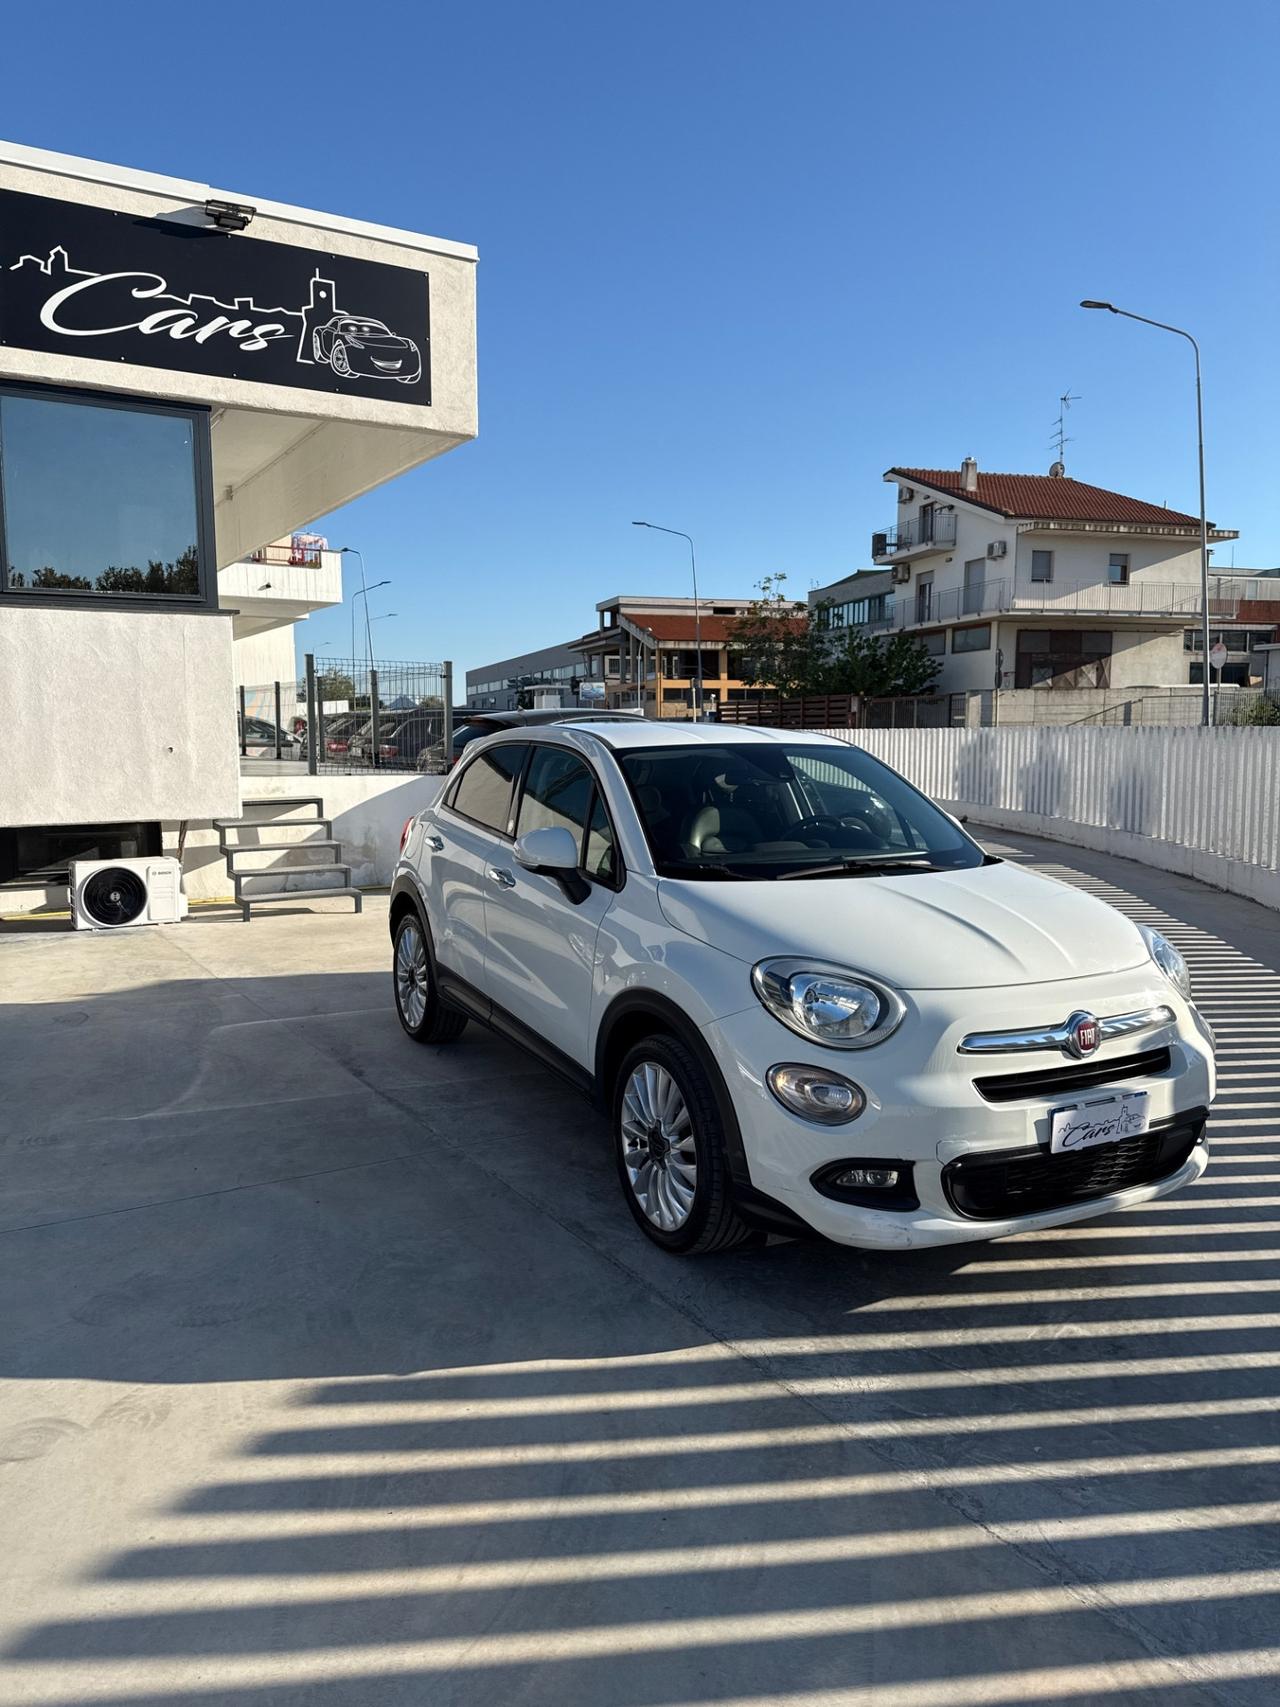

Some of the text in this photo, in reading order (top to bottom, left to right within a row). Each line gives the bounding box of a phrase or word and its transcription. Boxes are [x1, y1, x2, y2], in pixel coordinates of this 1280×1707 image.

[40, 272, 294, 350] Cars
[1080, 1027, 1095, 1046] FIAT
[1062, 1122, 1115, 1147] Cars
